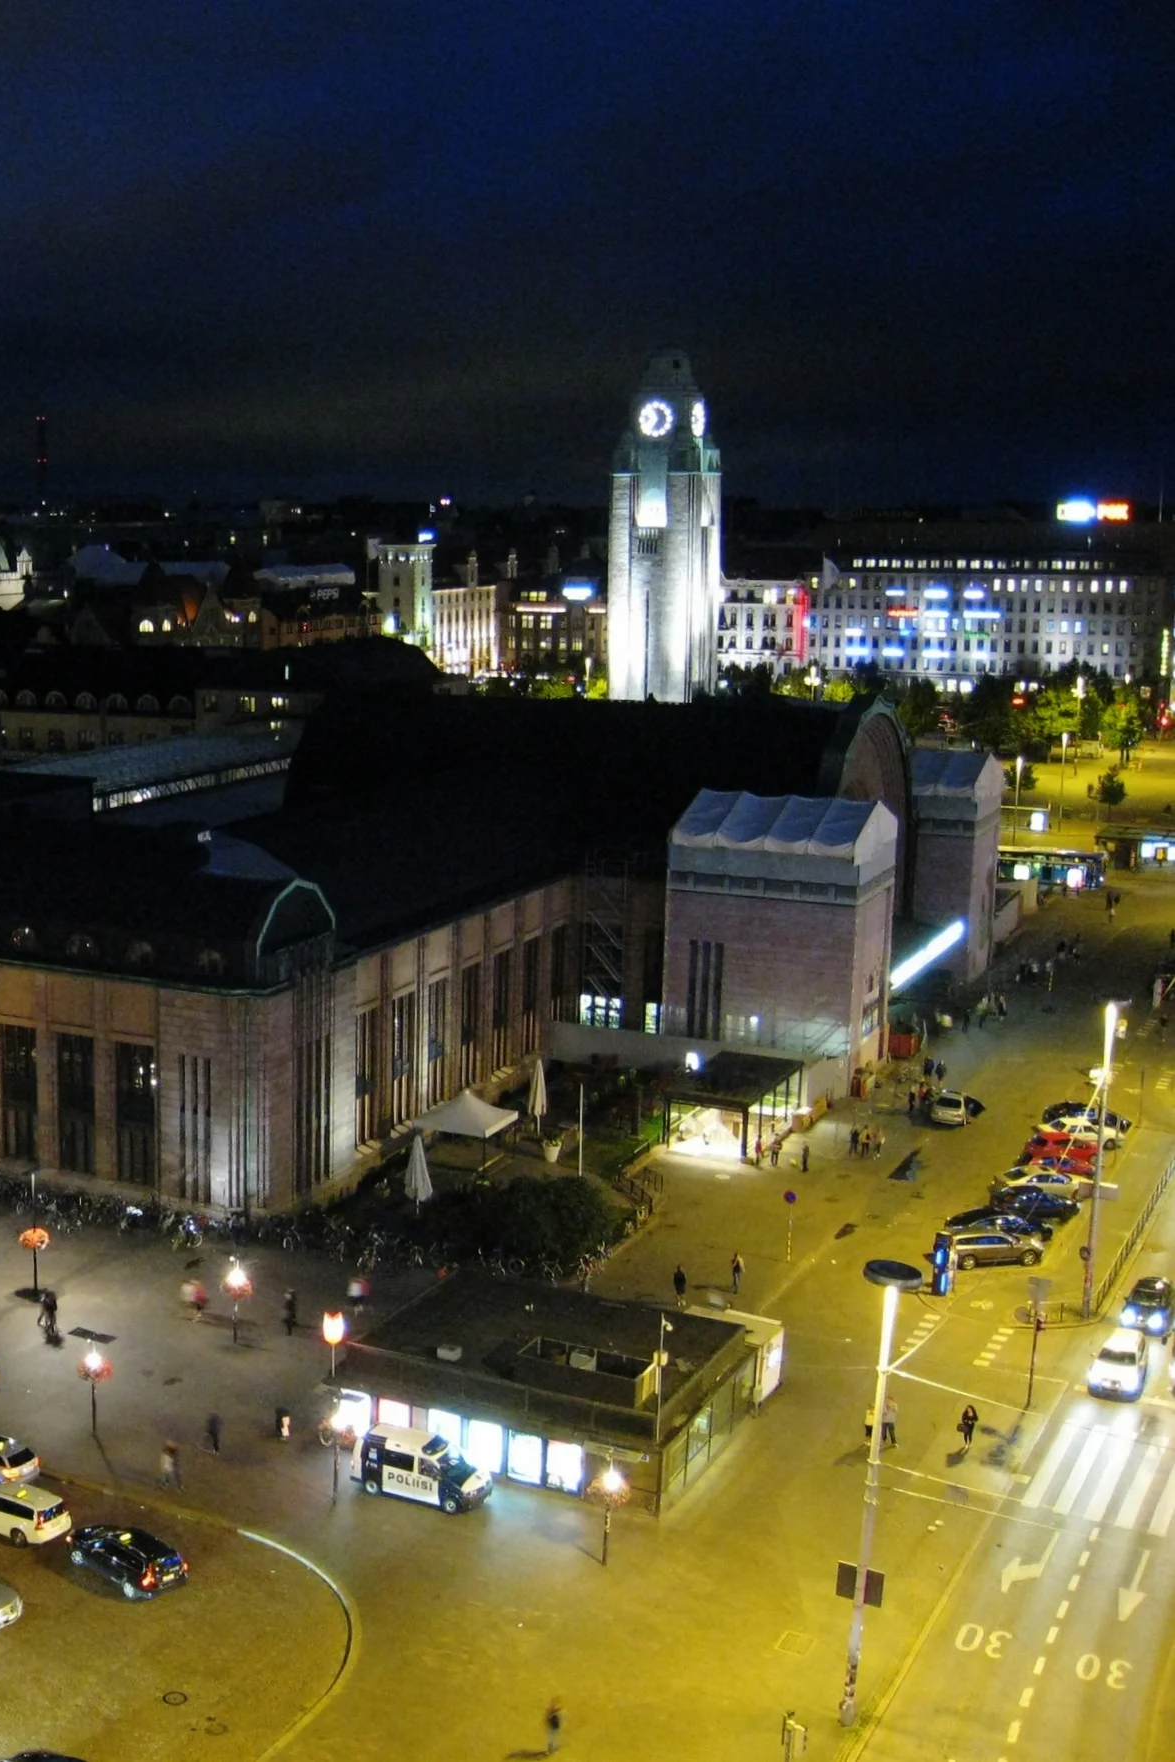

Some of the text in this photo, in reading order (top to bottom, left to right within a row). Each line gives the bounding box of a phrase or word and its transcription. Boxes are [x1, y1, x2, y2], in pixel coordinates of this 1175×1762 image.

[387, 1471, 433, 1492] POLIISI
[954, 1623, 1013, 1659] 30
[1075, 1653, 1133, 1689] 30
